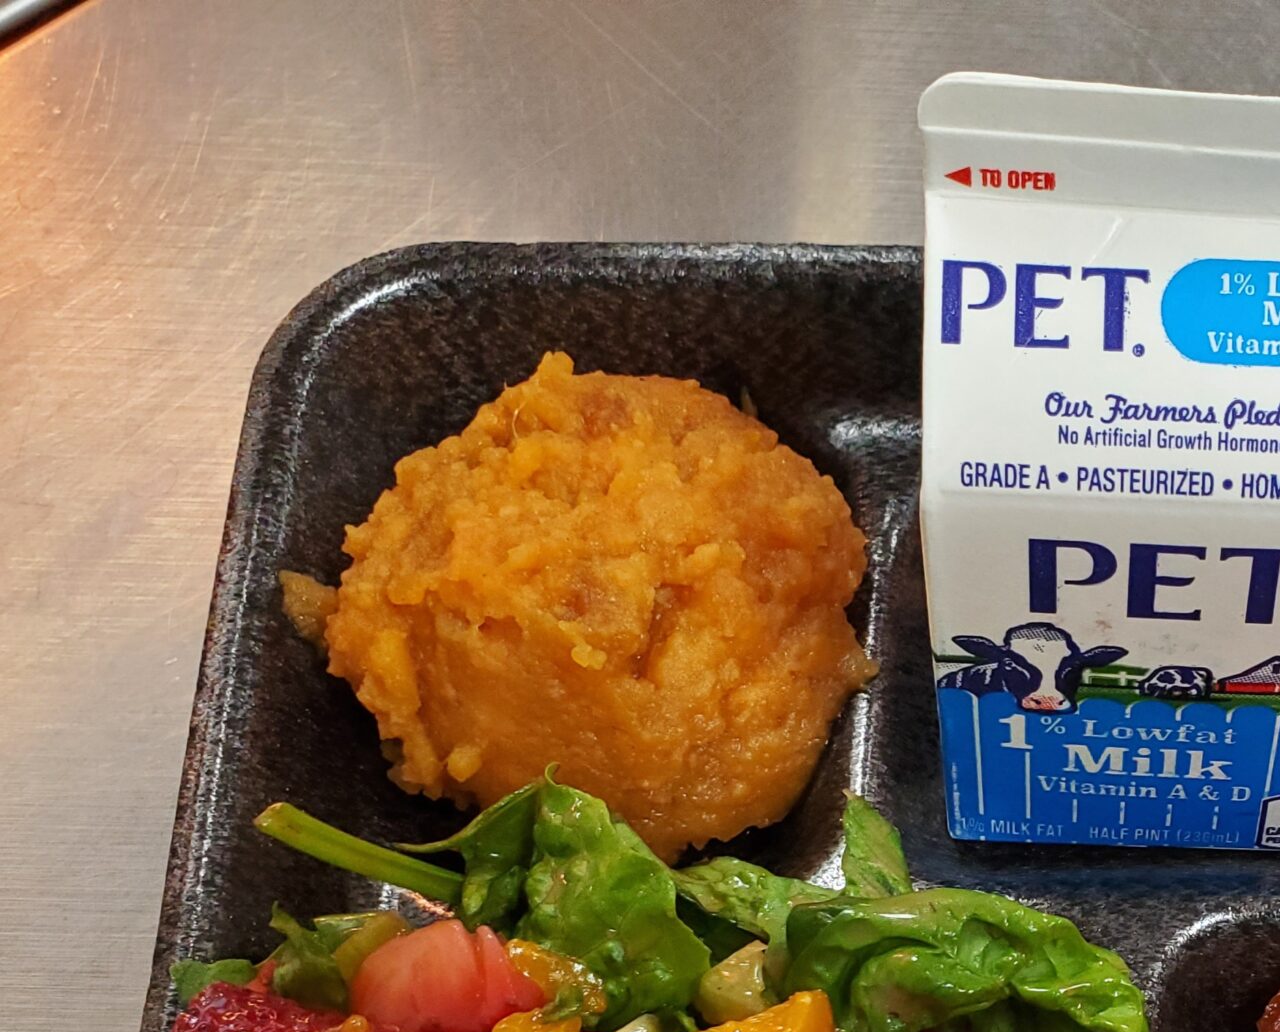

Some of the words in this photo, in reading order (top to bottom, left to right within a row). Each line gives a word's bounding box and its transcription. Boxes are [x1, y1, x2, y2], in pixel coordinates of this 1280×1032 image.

[979, 168, 1002, 188] TO
[1007, 170, 1056, 191] OPEN
[1219, 272, 1256, 296] 1%
[1045, 391, 1094, 419] Our
[1100, 393, 1218, 424] Farmers
[1057, 424, 1079, 445] No
[1084, 427, 1151, 449] Artificial
[1157, 428, 1212, 450] Growth
[960, 461, 1031, 489] GRADE
[1035, 465, 1051, 490] A
[1076, 466, 1215, 497] PASTEURIZED
[1082, 718, 1239, 745] Lowfat
[1062, 743, 1233, 781] Milk
[1037, 774, 1157, 799] Vitamin
[1167, 783, 1188, 800] A
[1199, 785, 1221, 801] &
[1231, 786, 1252, 802] D
[991, 819, 1030, 836] MILK
[1036, 823, 1064, 837] FAT
[1089, 826, 1128, 840] HALF
[1134, 827, 1170, 841] PINT
